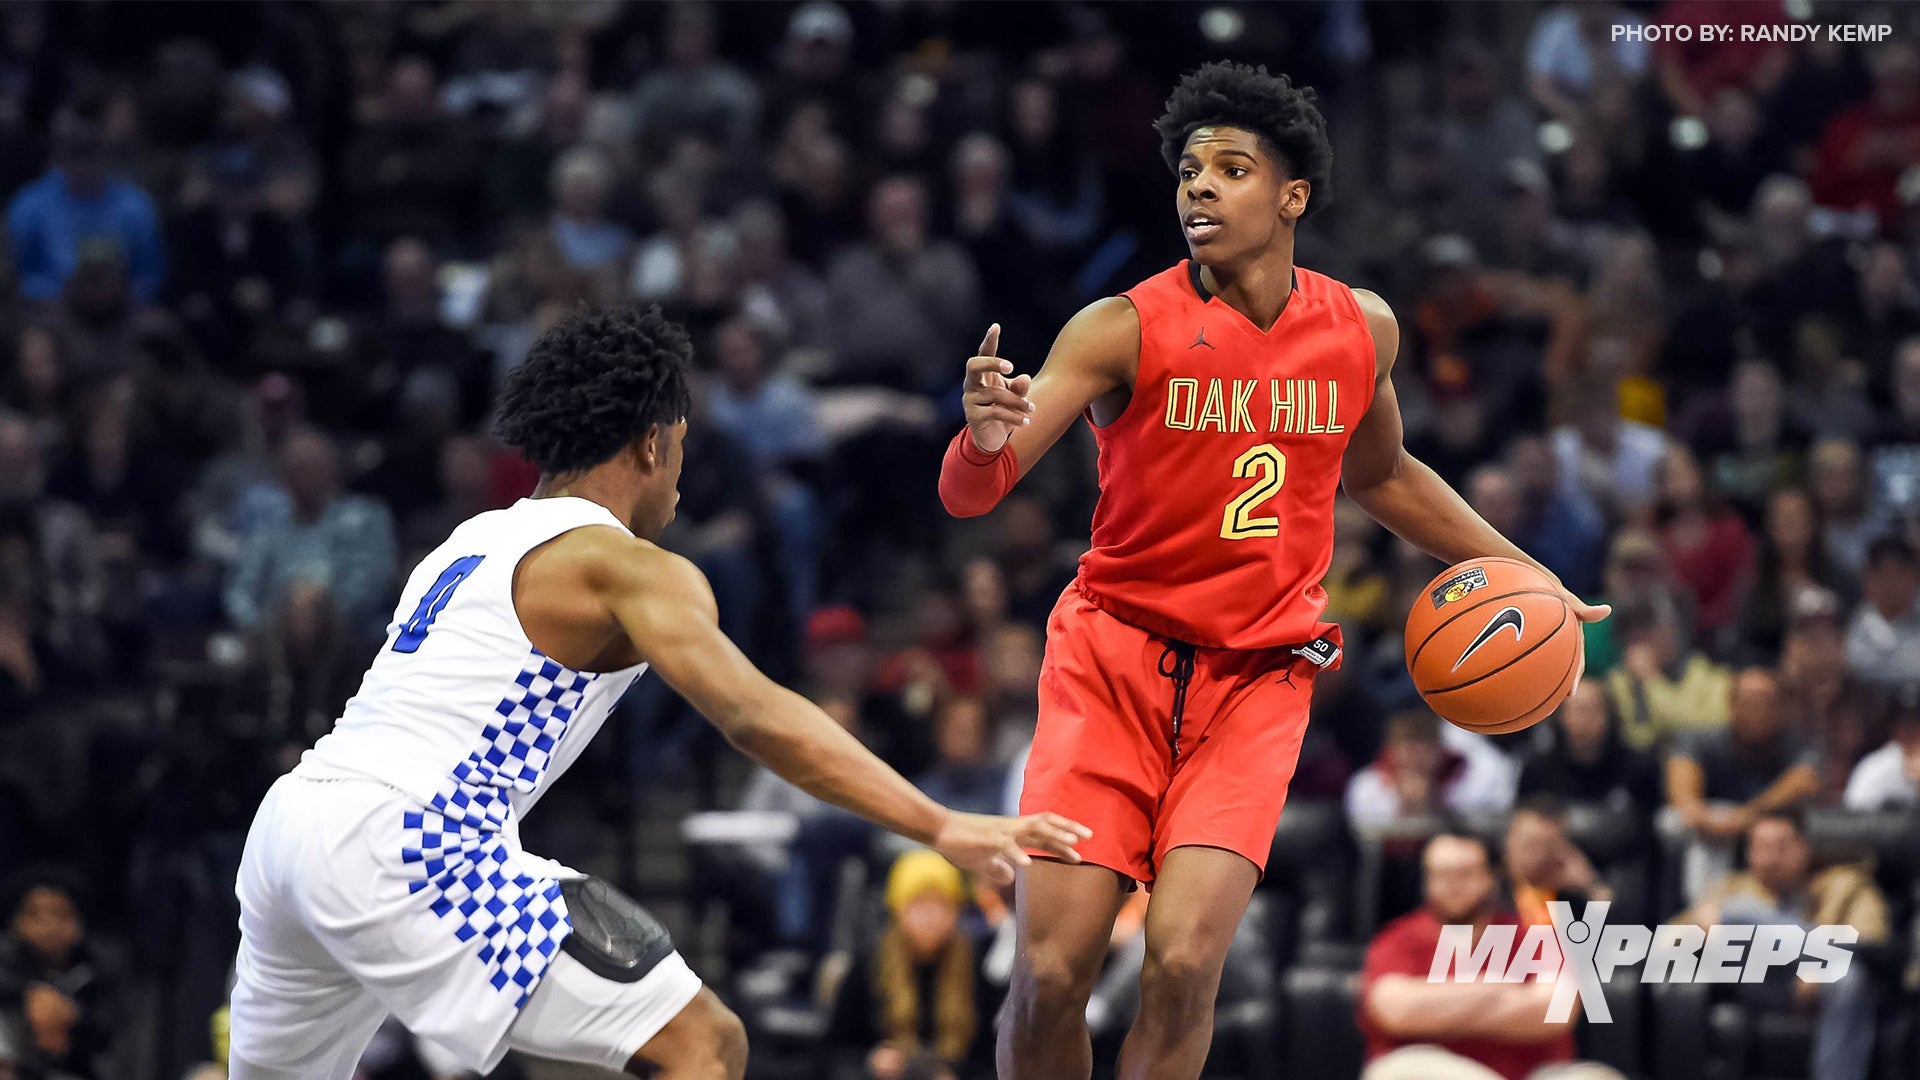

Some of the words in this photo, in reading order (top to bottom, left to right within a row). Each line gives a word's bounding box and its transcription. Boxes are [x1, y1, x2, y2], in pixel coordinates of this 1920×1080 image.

[1164, 377, 1259, 433] OAK
[1268, 378, 1345, 434] HILL
[1219, 443, 1287, 540] 2
[391, 554, 487, 653] 0
[1313, 639, 1329, 653] 50
